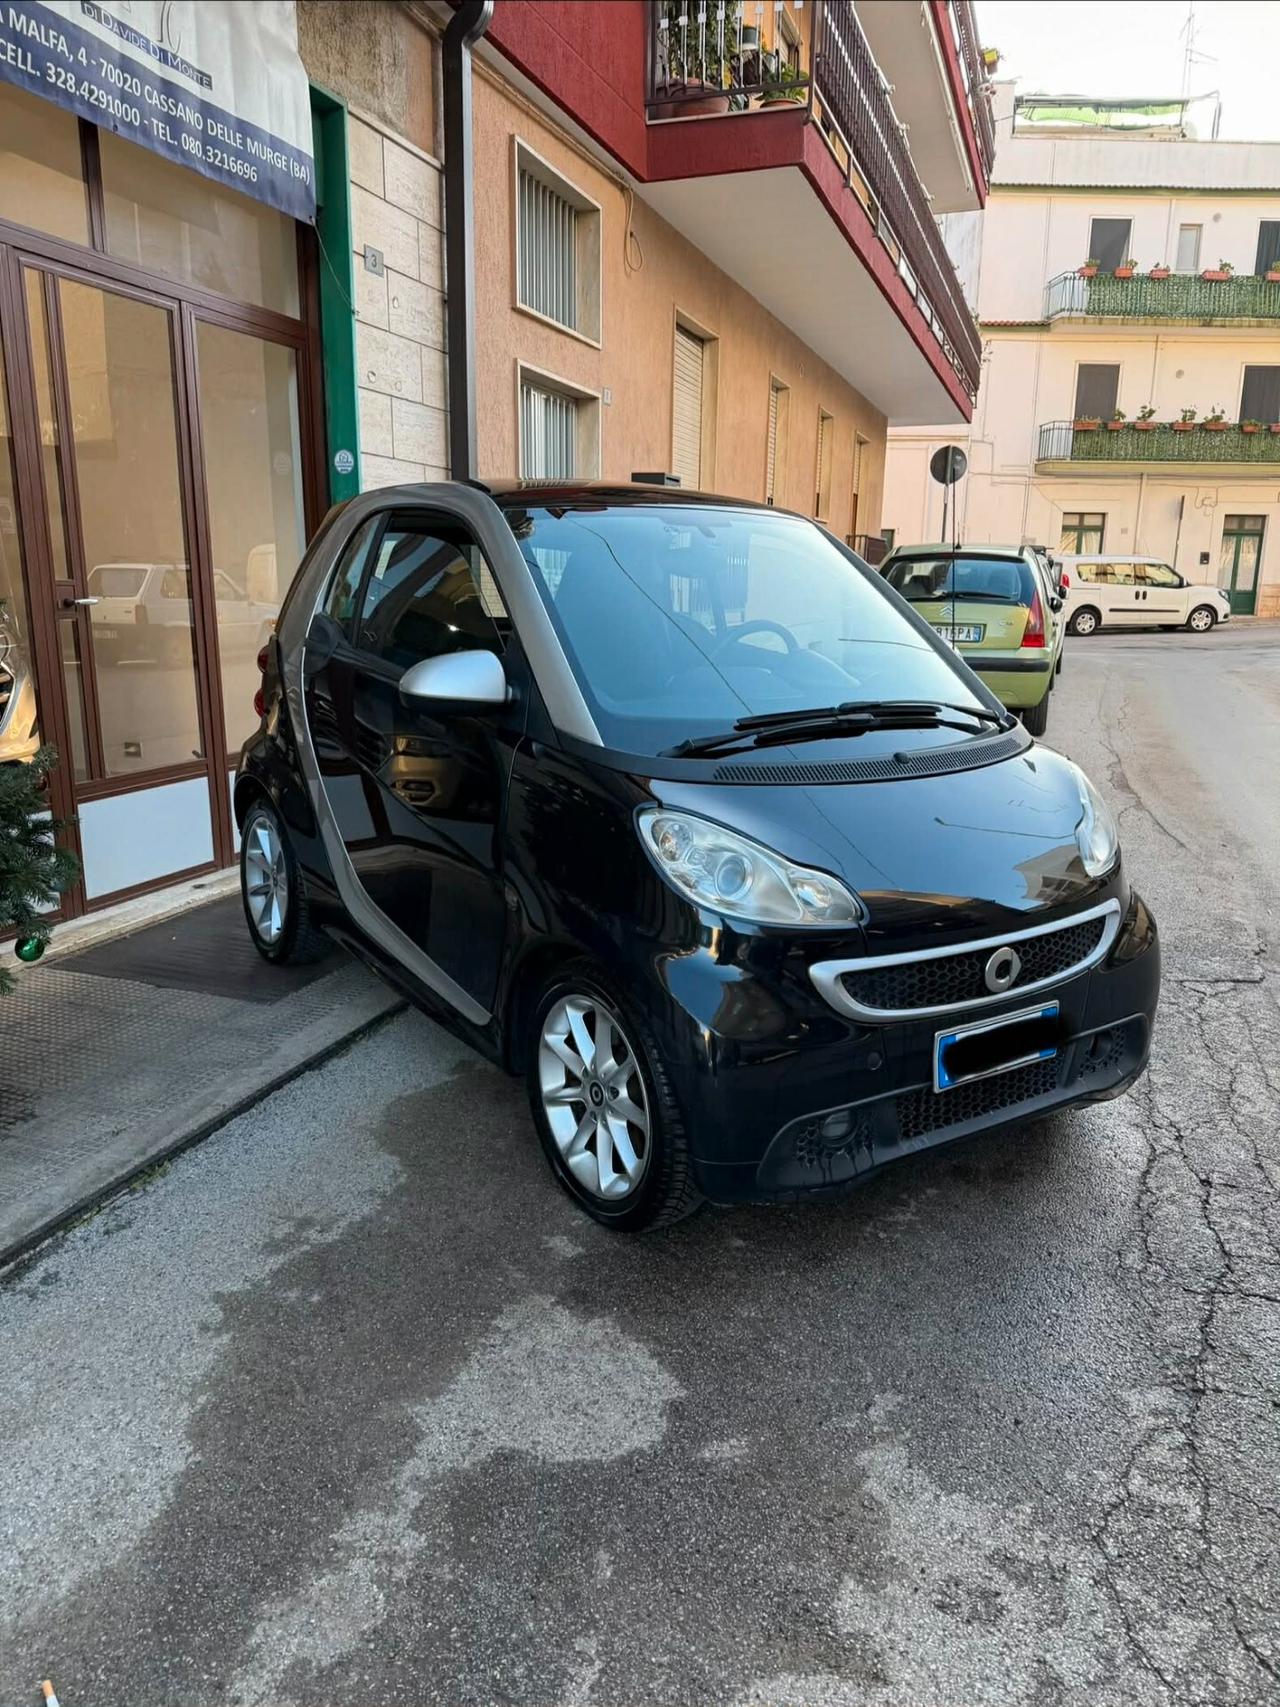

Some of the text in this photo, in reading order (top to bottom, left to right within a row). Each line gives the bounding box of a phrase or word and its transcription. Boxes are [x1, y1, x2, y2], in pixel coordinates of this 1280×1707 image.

[9, 7, 74, 62] MALFA,
[77, 46, 88, 67] 4
[99, 58, 141, 97] 70020
[144, 85, 204, 130] CASSANO
[207, 118, 244, 150] DELLE
[246, 136, 288, 172] MURGE
[290, 158, 310, 186] (BA)
[84, 3, 98, 21] DI
[101, 9, 148, 54] DAVIDE
[149, 41, 164, 63] DI
[168, 51, 210, 89] MONTE
[0, 38, 41, 77] CELL.
[46, 61, 141, 127] 328.4291000
[150, 117, 178, 146] TEL.
[181, 132, 258, 182] 080.3216696
[371, 254, 378, 268] 3
